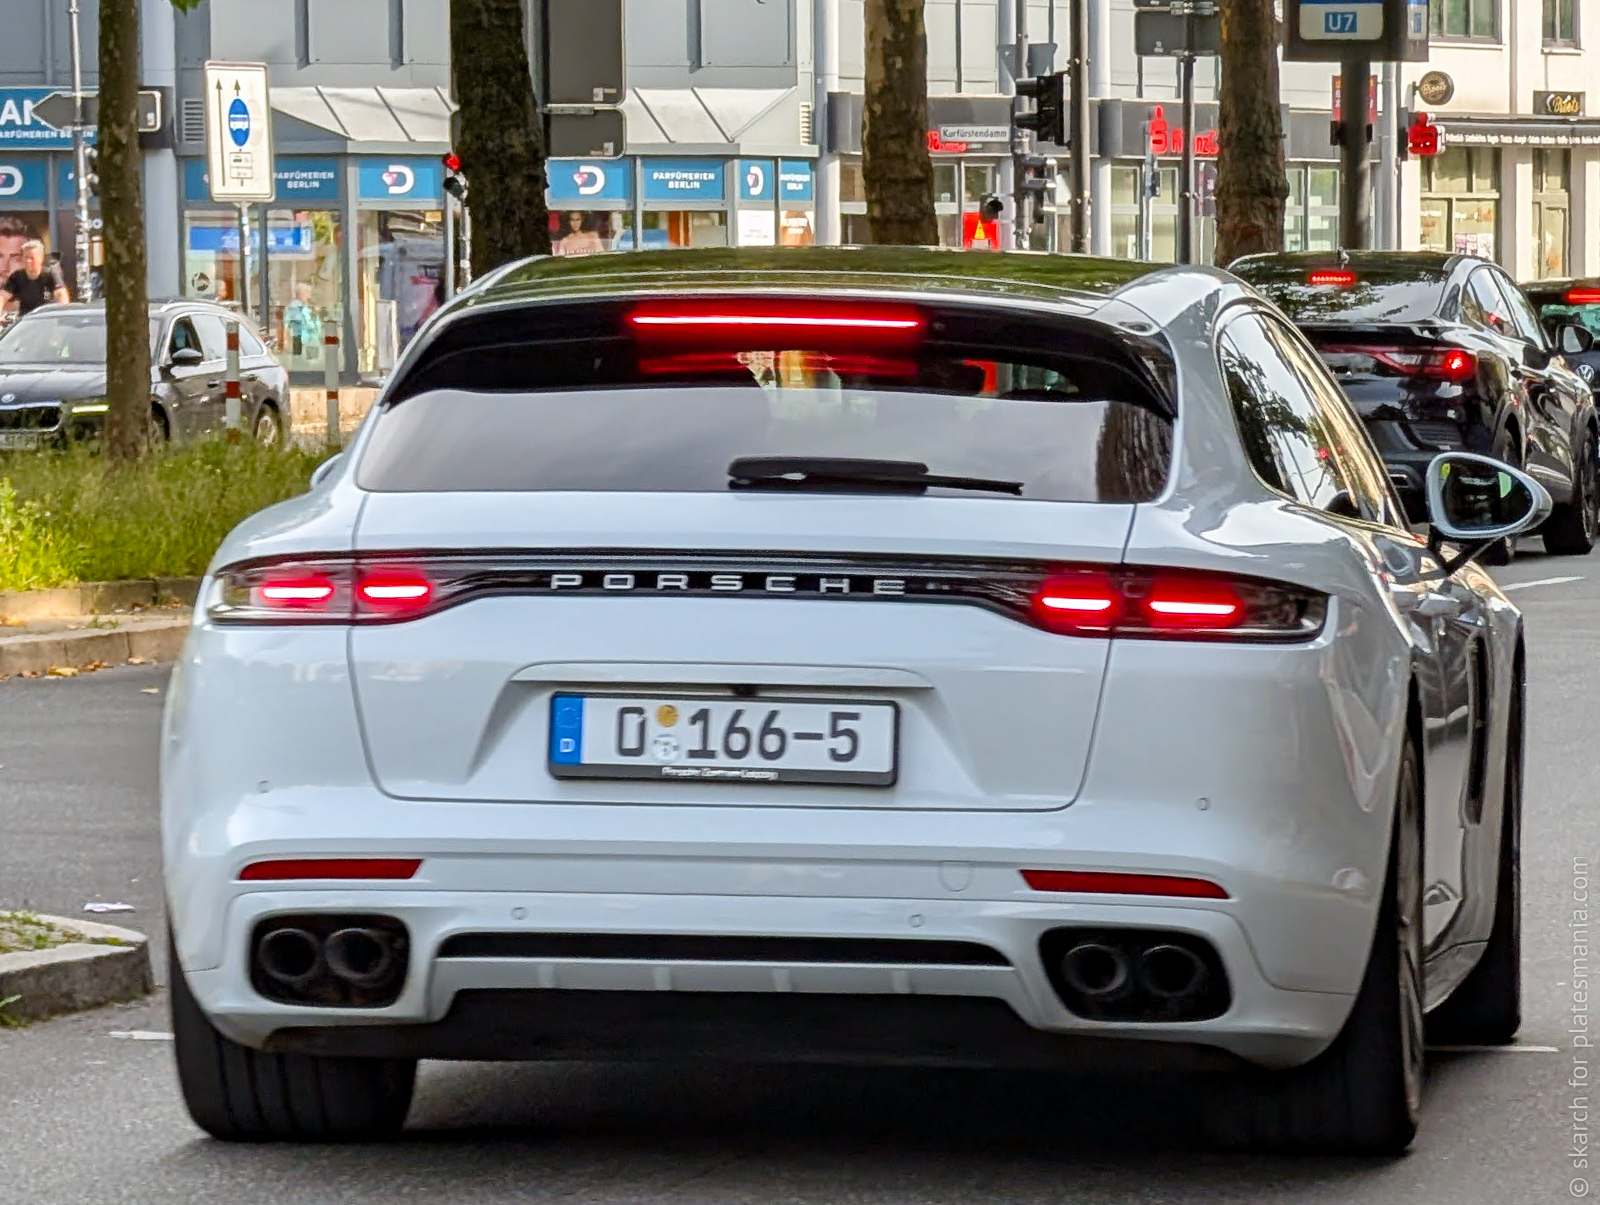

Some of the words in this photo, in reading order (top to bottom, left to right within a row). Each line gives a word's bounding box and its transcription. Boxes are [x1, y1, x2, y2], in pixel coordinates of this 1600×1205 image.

[1328, 14, 1354, 31] U7
[942, 128, 1007, 138] Kurfürstendamm
[653, 171, 715, 180] PARFÜMERIEN
[287, 180, 320, 189] BERLIN
[668, 181, 700, 189] BERLIN
[550, 574, 906, 596] PORSCHE
[687, 707, 862, 762] 166-5
[560, 738, 575, 752] D
